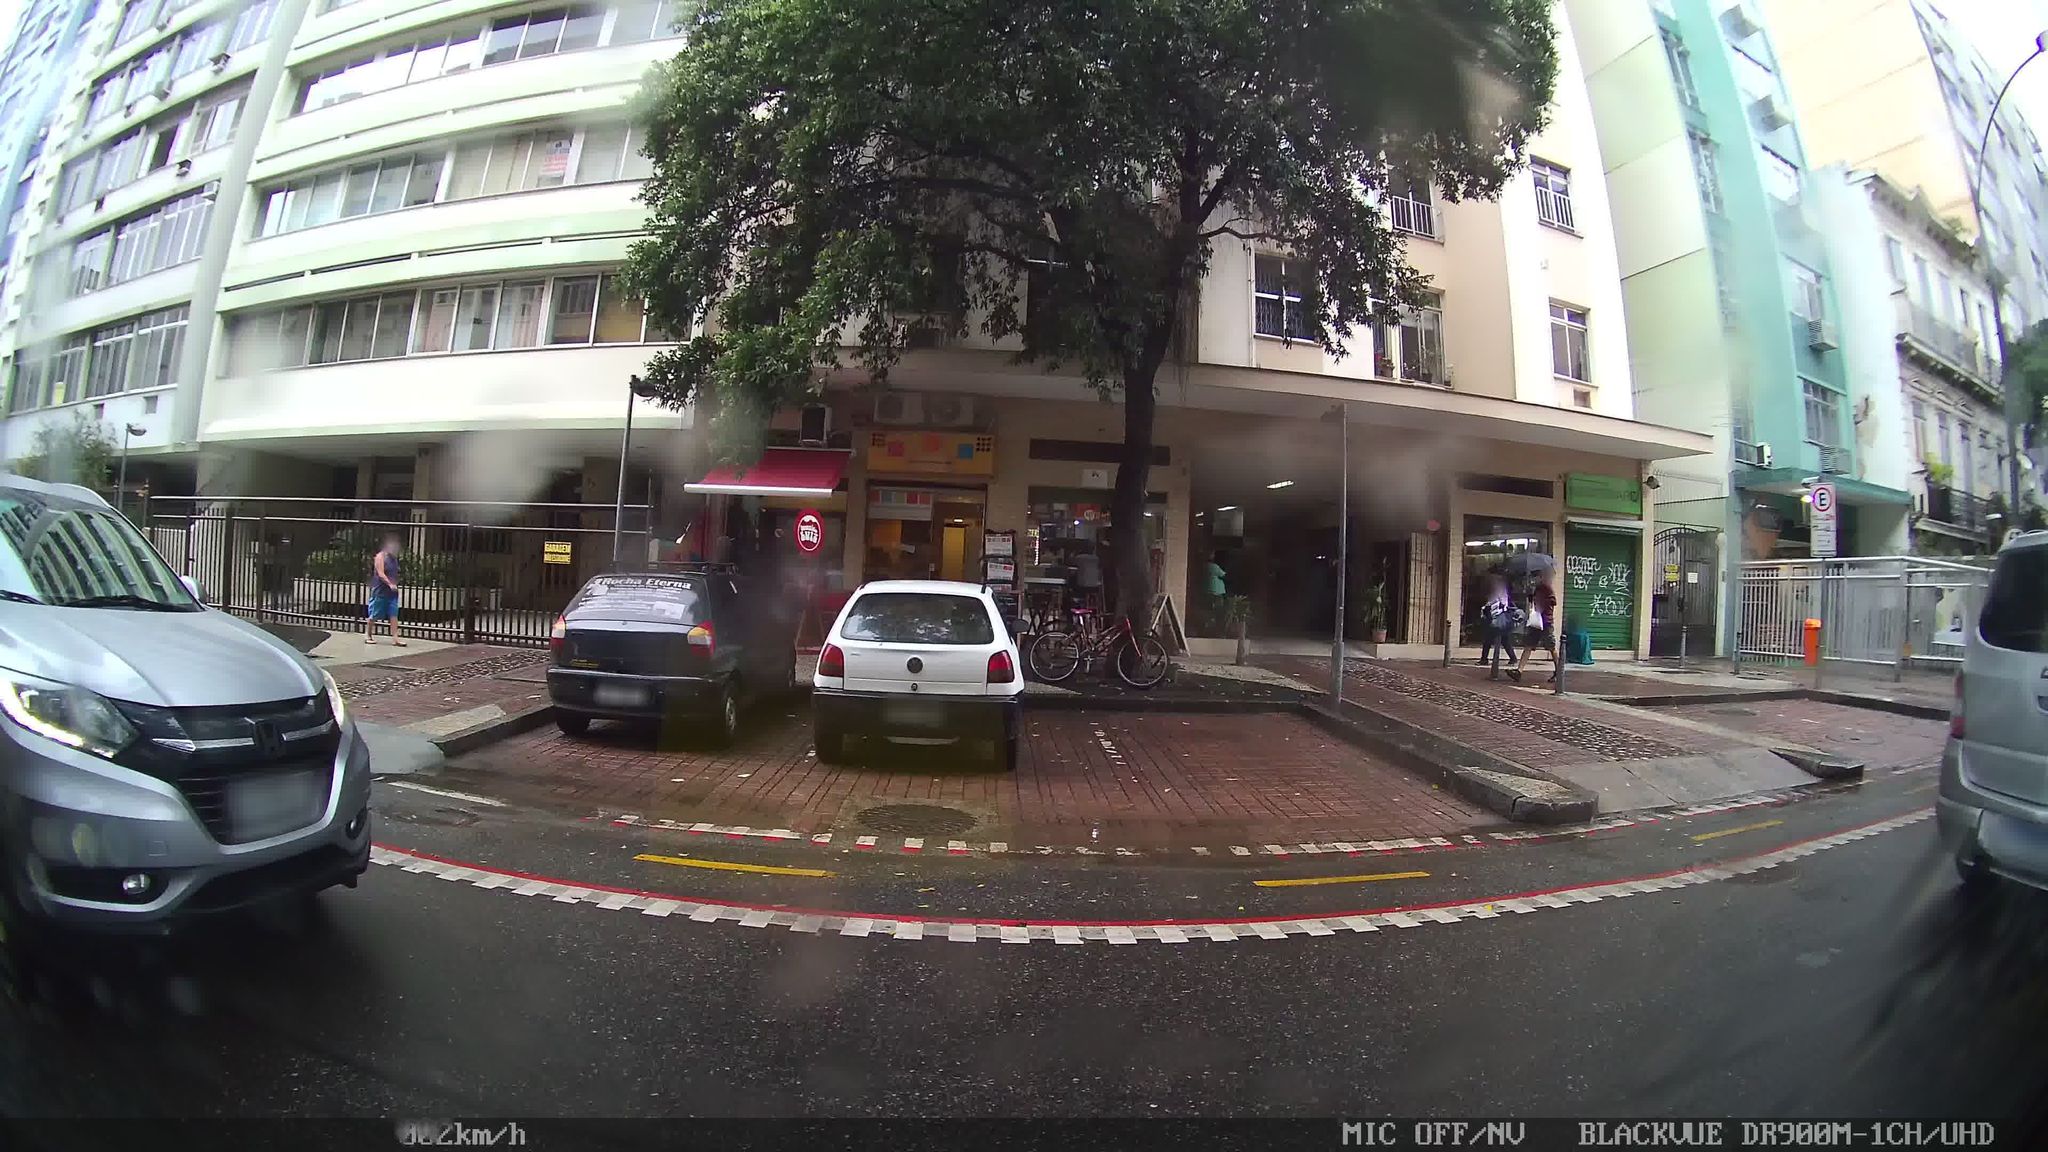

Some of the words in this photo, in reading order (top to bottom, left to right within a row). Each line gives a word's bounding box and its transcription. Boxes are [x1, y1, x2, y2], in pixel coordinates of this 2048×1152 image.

[1819, 492, 1827, 506] E
[601, 577, 642, 585] Rocha
[646, 578, 692, 589] Eterna
